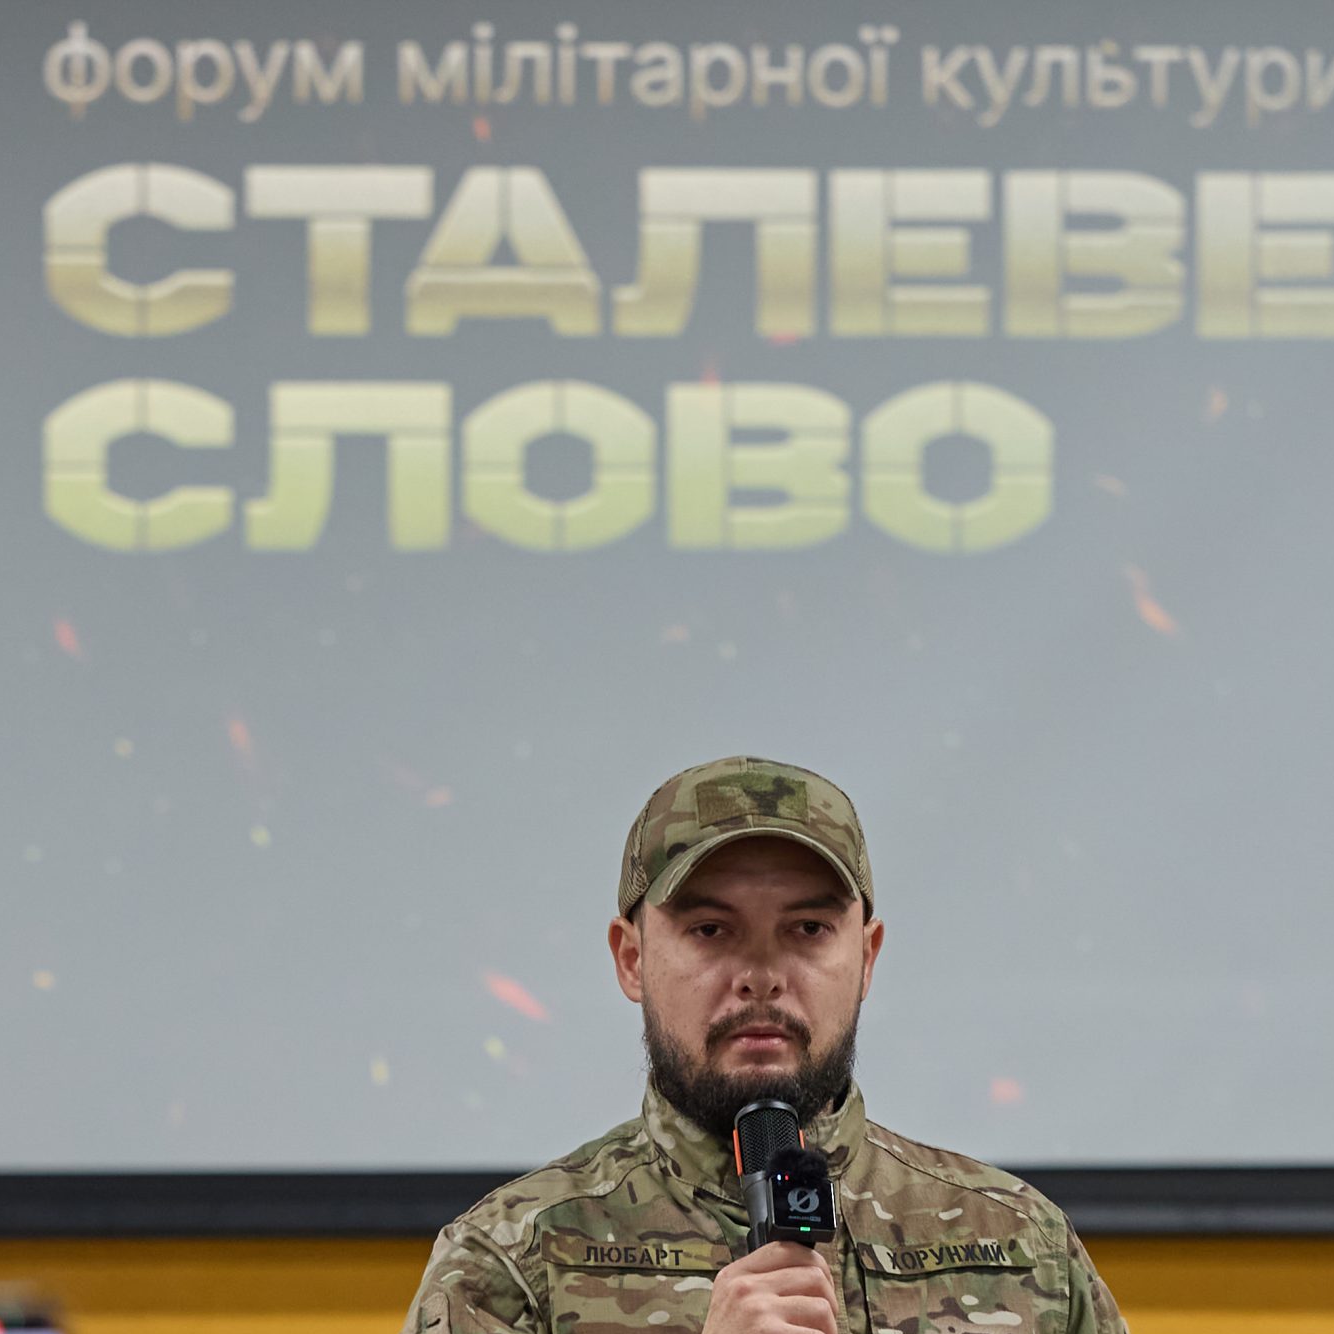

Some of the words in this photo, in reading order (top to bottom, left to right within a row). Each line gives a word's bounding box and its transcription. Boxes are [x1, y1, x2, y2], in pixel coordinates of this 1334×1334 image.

[42, 21, 363, 124] форум
[398, 21, 900, 124] мілітарної
[42, 377, 1056, 554] СЛОВО
[582, 1244, 684, 1267] ЛЮБАРТ
[886, 1241, 1008, 1270] ХОРУНЖИЙ
